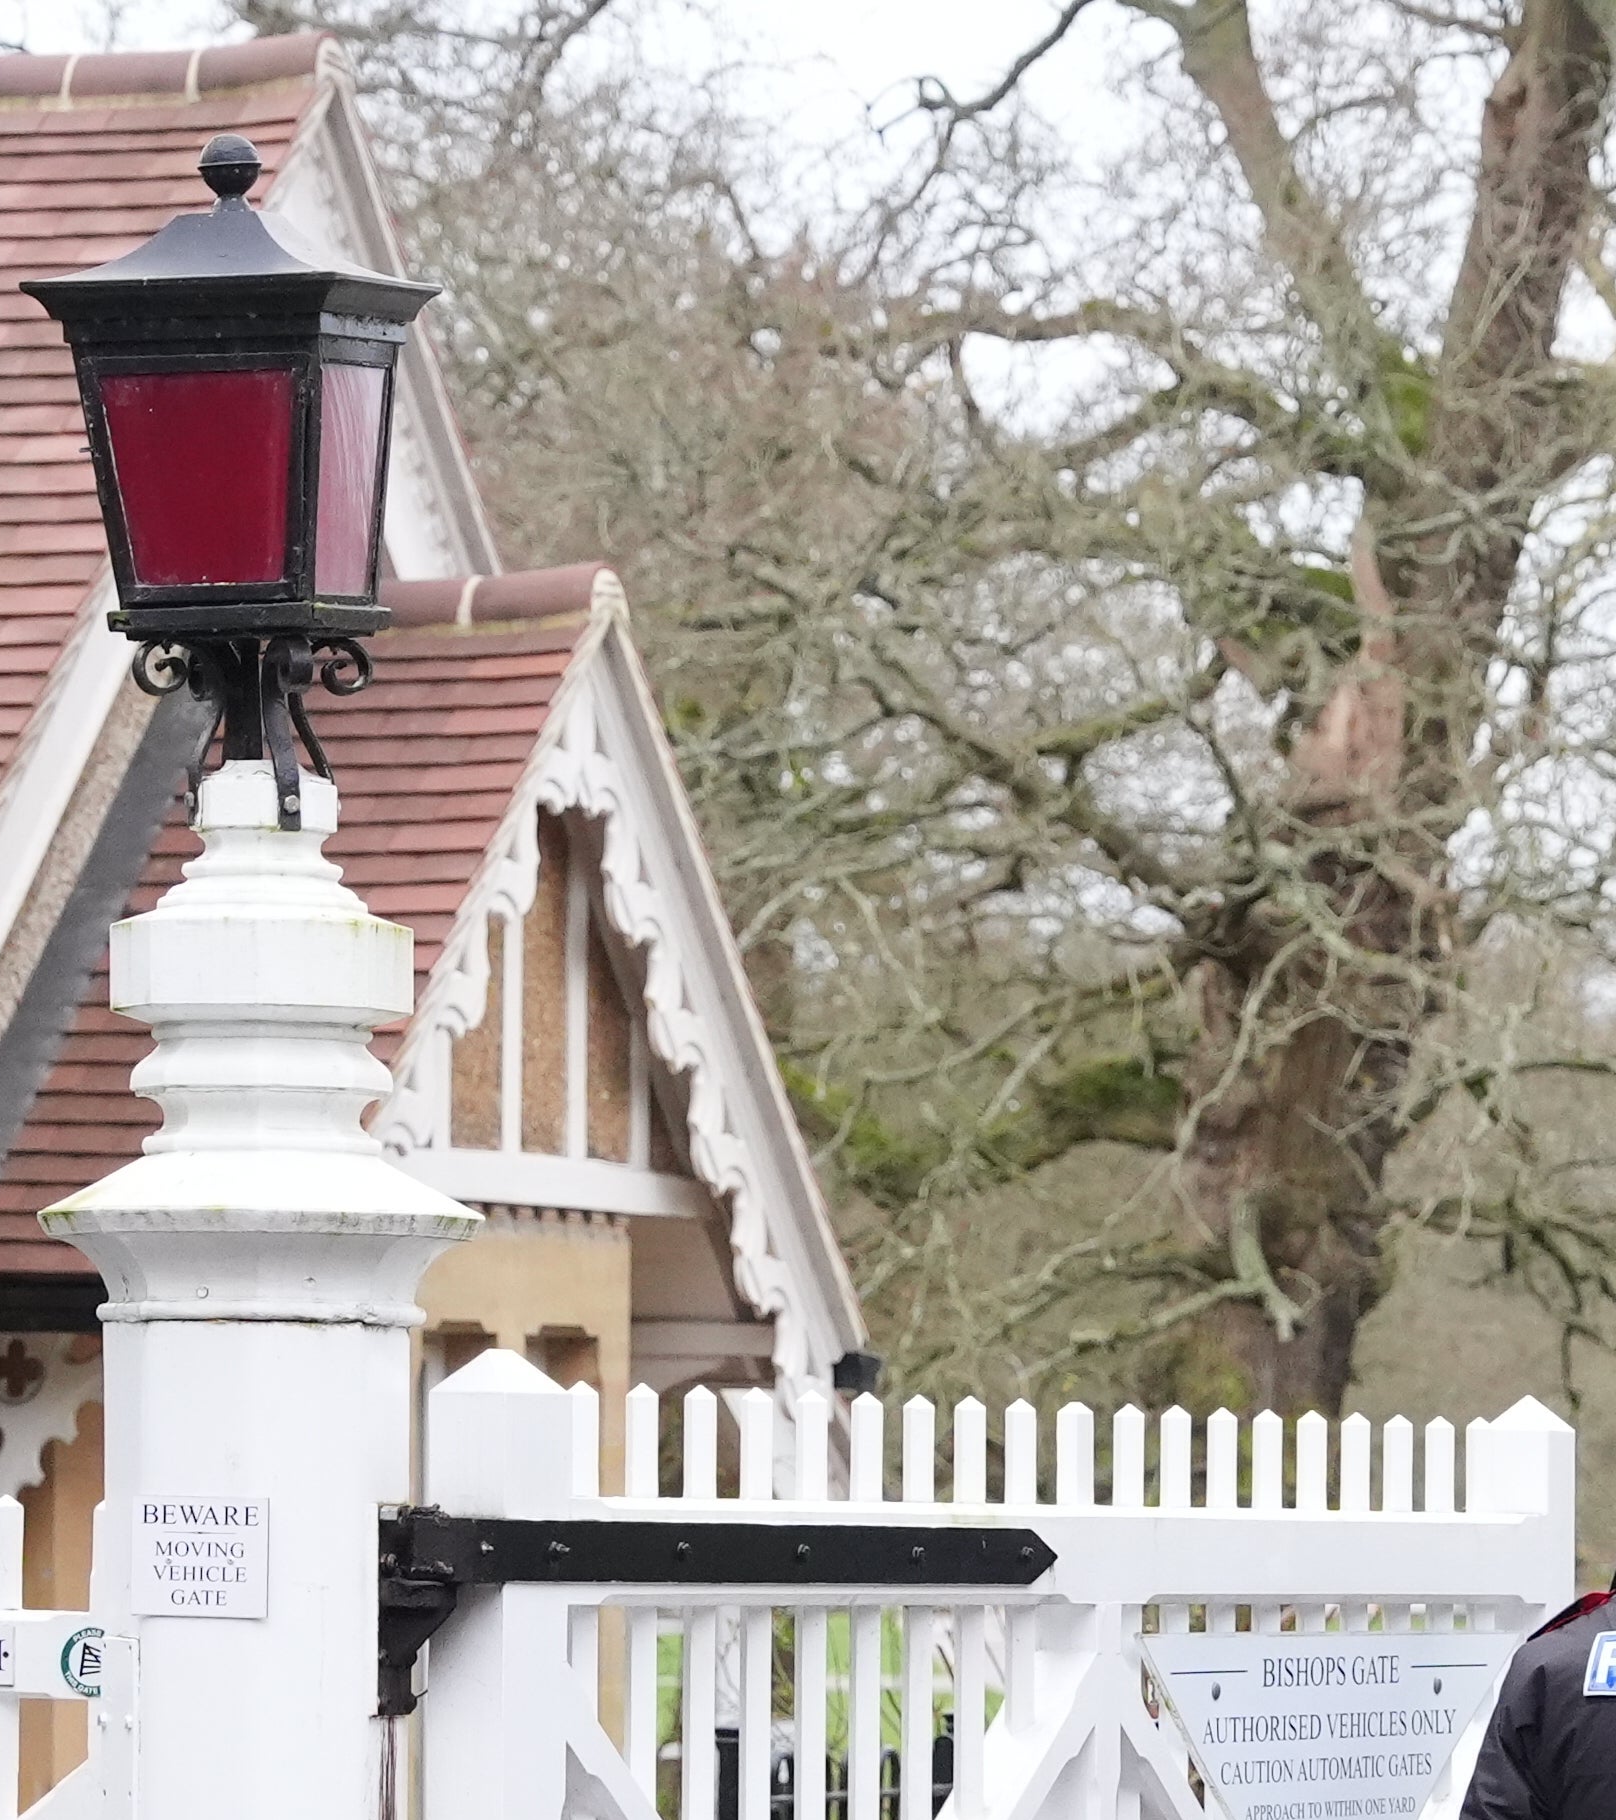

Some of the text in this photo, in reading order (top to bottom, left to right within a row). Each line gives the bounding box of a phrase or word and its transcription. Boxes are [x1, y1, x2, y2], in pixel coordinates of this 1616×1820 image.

[142, 1504, 259, 1527] BEWARE
[155, 1541, 245, 1559] MOVING
[153, 1565, 247, 1583] VEHICLE
[171, 1589, 227, 1606] GATE
[73, 1628, 102, 1641] PLEASE
[1263, 1655, 1400, 1688] BISHOPS GATE
[1203, 1709, 1457, 1744] AUTHORISED VEHICLES ONLY
[1220, 1753, 1432, 1785] CAUTION AUTOMATIC GATES
[1307, 1802, 1322, 1818] TO
[1325, 1799, 1363, 1817] WITHIN
[1365, 1798, 1385, 1815] ONE
[1388, 1796, 1416, 1813] YARD
